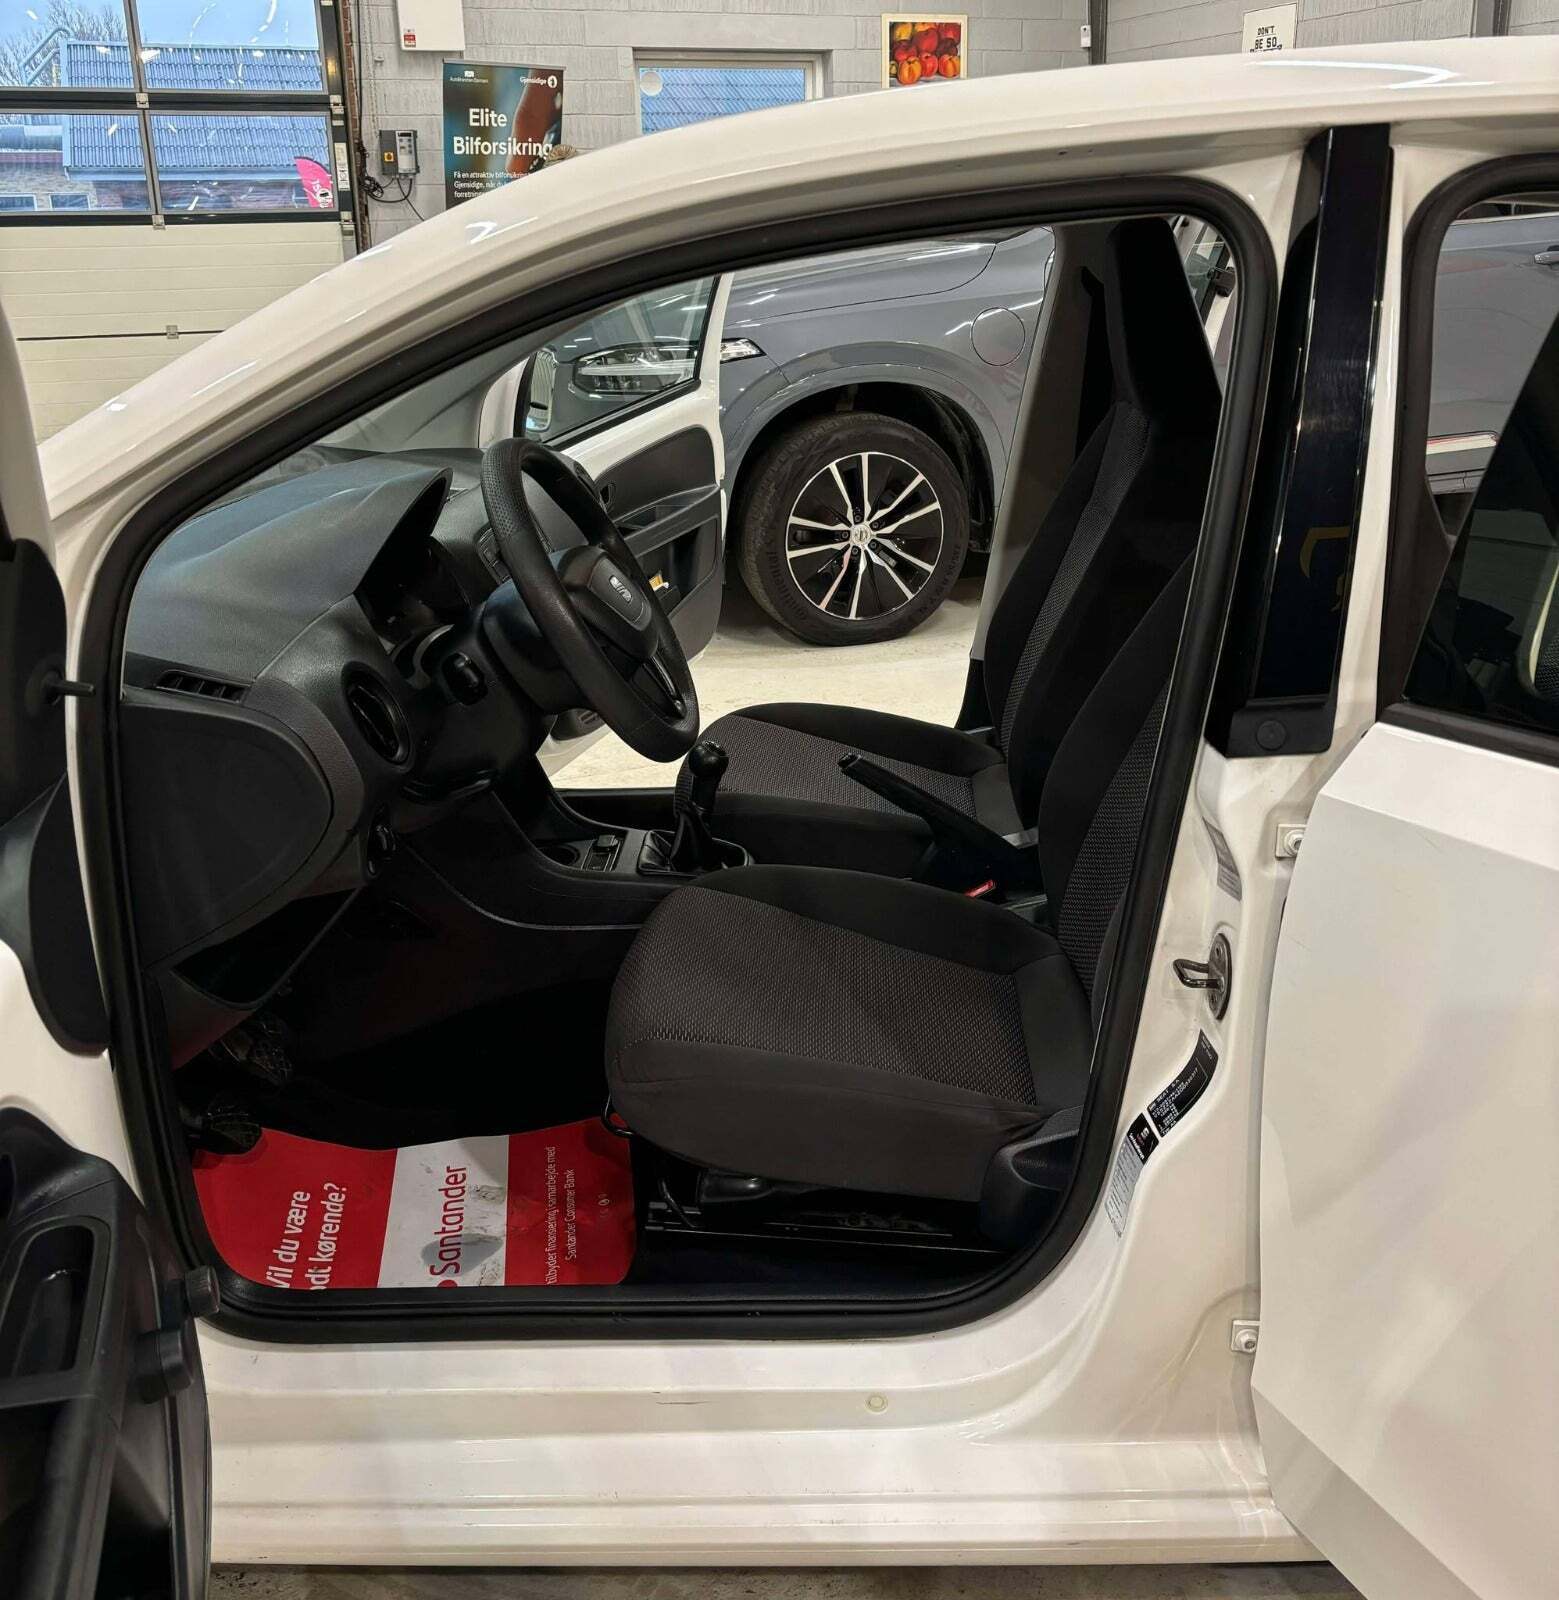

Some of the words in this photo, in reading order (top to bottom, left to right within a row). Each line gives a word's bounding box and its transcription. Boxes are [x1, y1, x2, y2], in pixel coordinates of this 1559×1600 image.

[1255, 38, 1264, 49] BE
[1266, 36, 1277, 48] SO
[469, 108, 508, 127] Elite
[453, 136, 552, 160] Bilforsikring
[545, 1146, 556, 1163] med
[564, 1169, 575, 1189] Bank
[285, 1191, 311, 1234] være
[564, 1189, 576, 1222] Consumer
[308, 1182, 347, 1262] kørende?
[430, 1165, 467, 1276] Santander
[273, 1239, 299, 1263] du
[564, 1222, 577, 1261] Santander
